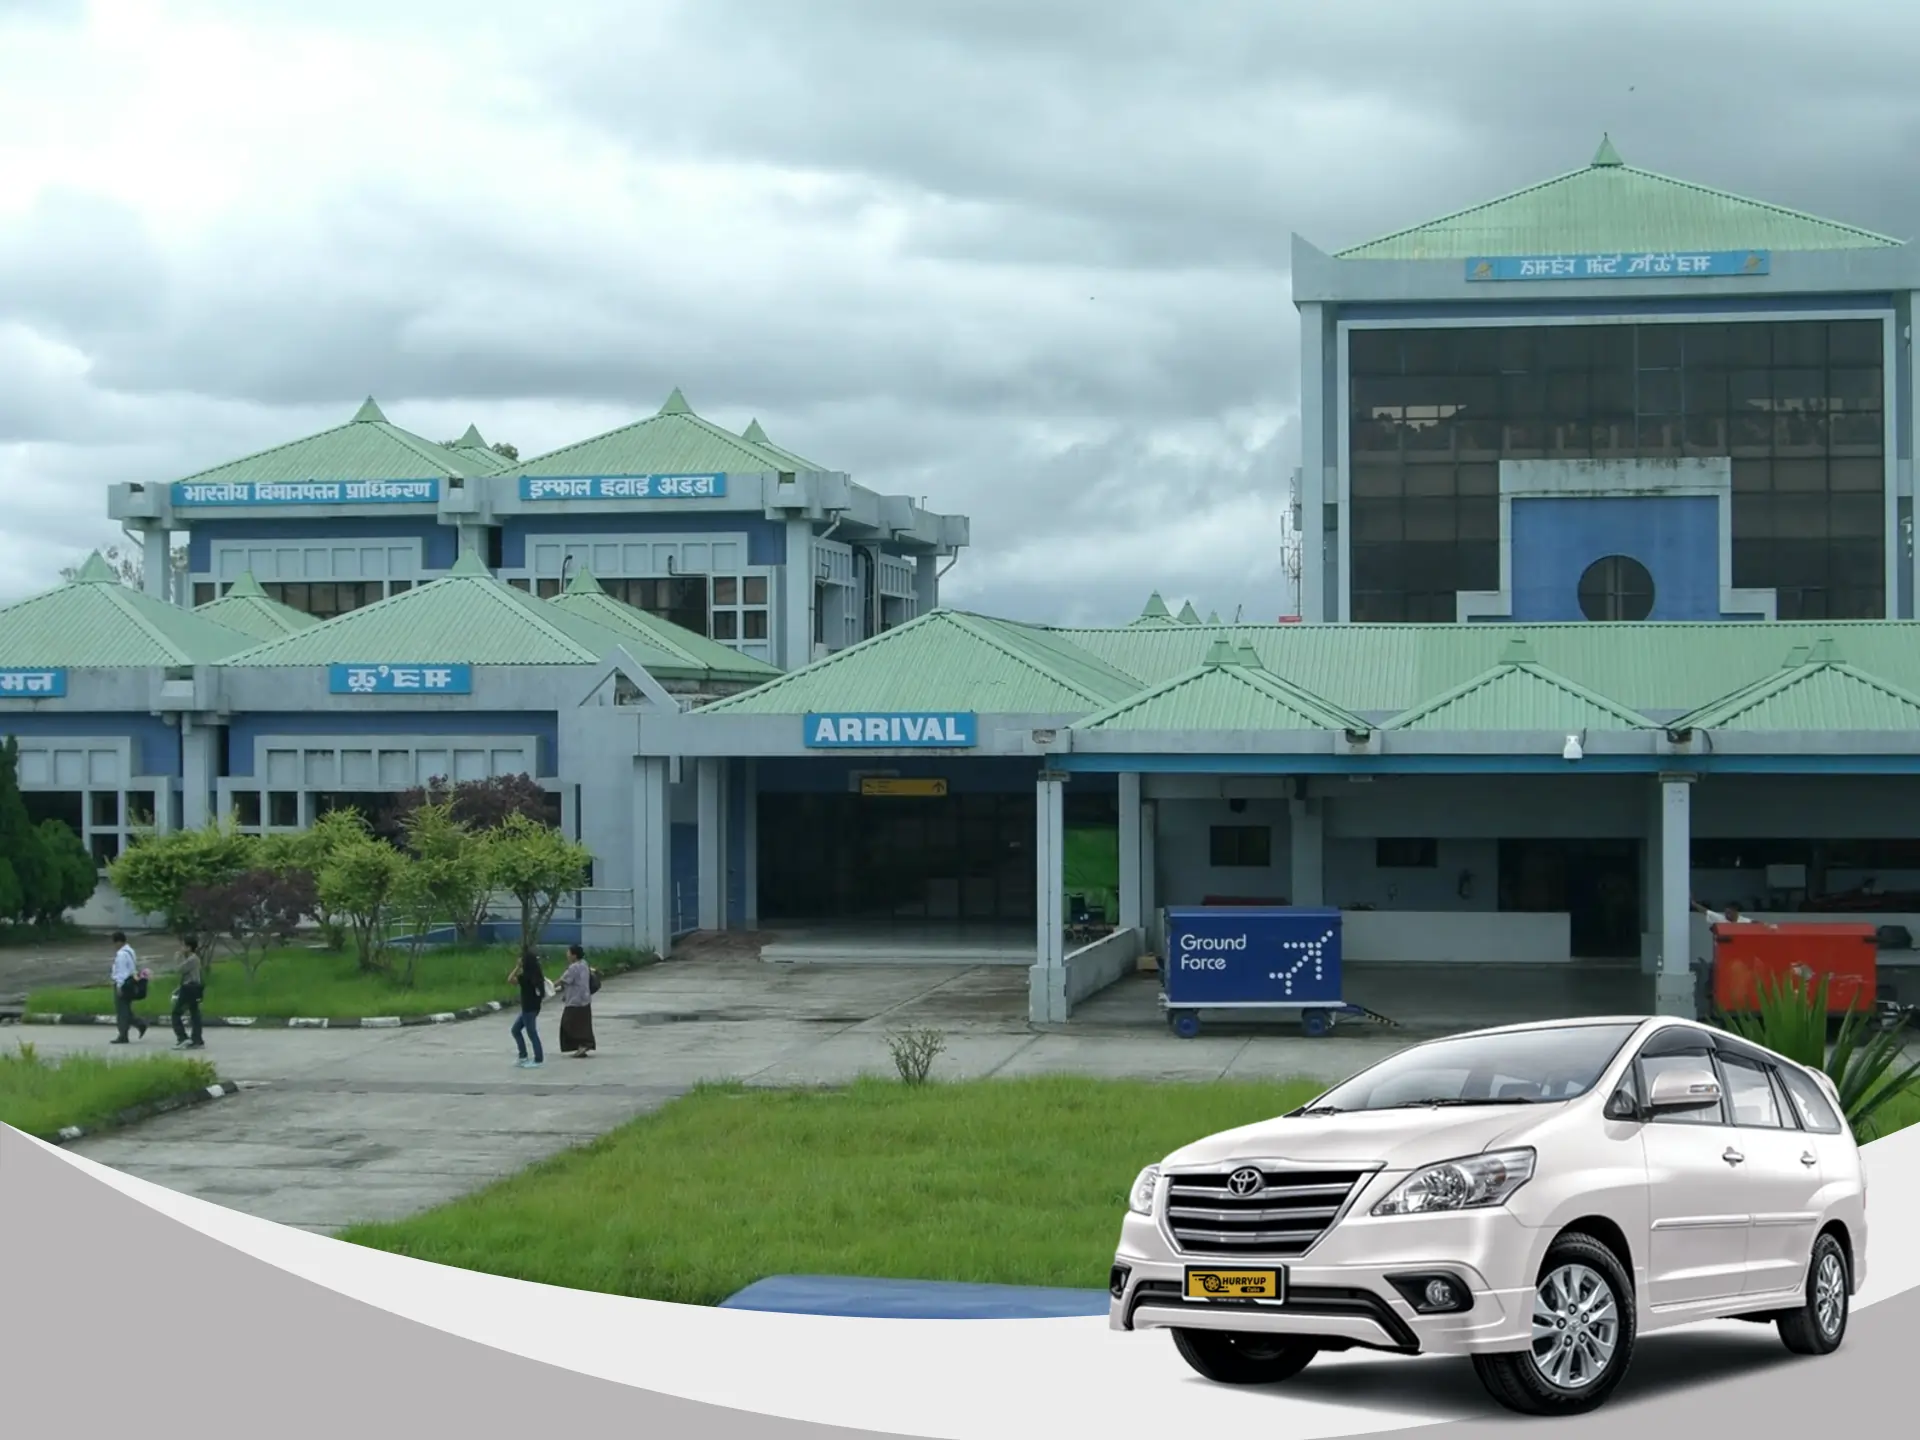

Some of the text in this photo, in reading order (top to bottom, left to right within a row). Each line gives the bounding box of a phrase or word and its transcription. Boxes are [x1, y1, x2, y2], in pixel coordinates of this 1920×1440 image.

[183, 480, 432, 502] भारतीय विमानपत्तन प्राधिकरण
[528, 475, 716, 499] इम्फाल हवाई अड्डा
[814, 717, 967, 743] ARRIVAL
[1180, 933, 1246, 951] Ground
[1180, 953, 1227, 971] Force
[1222, 1276, 1267, 1286] HURRYUP
